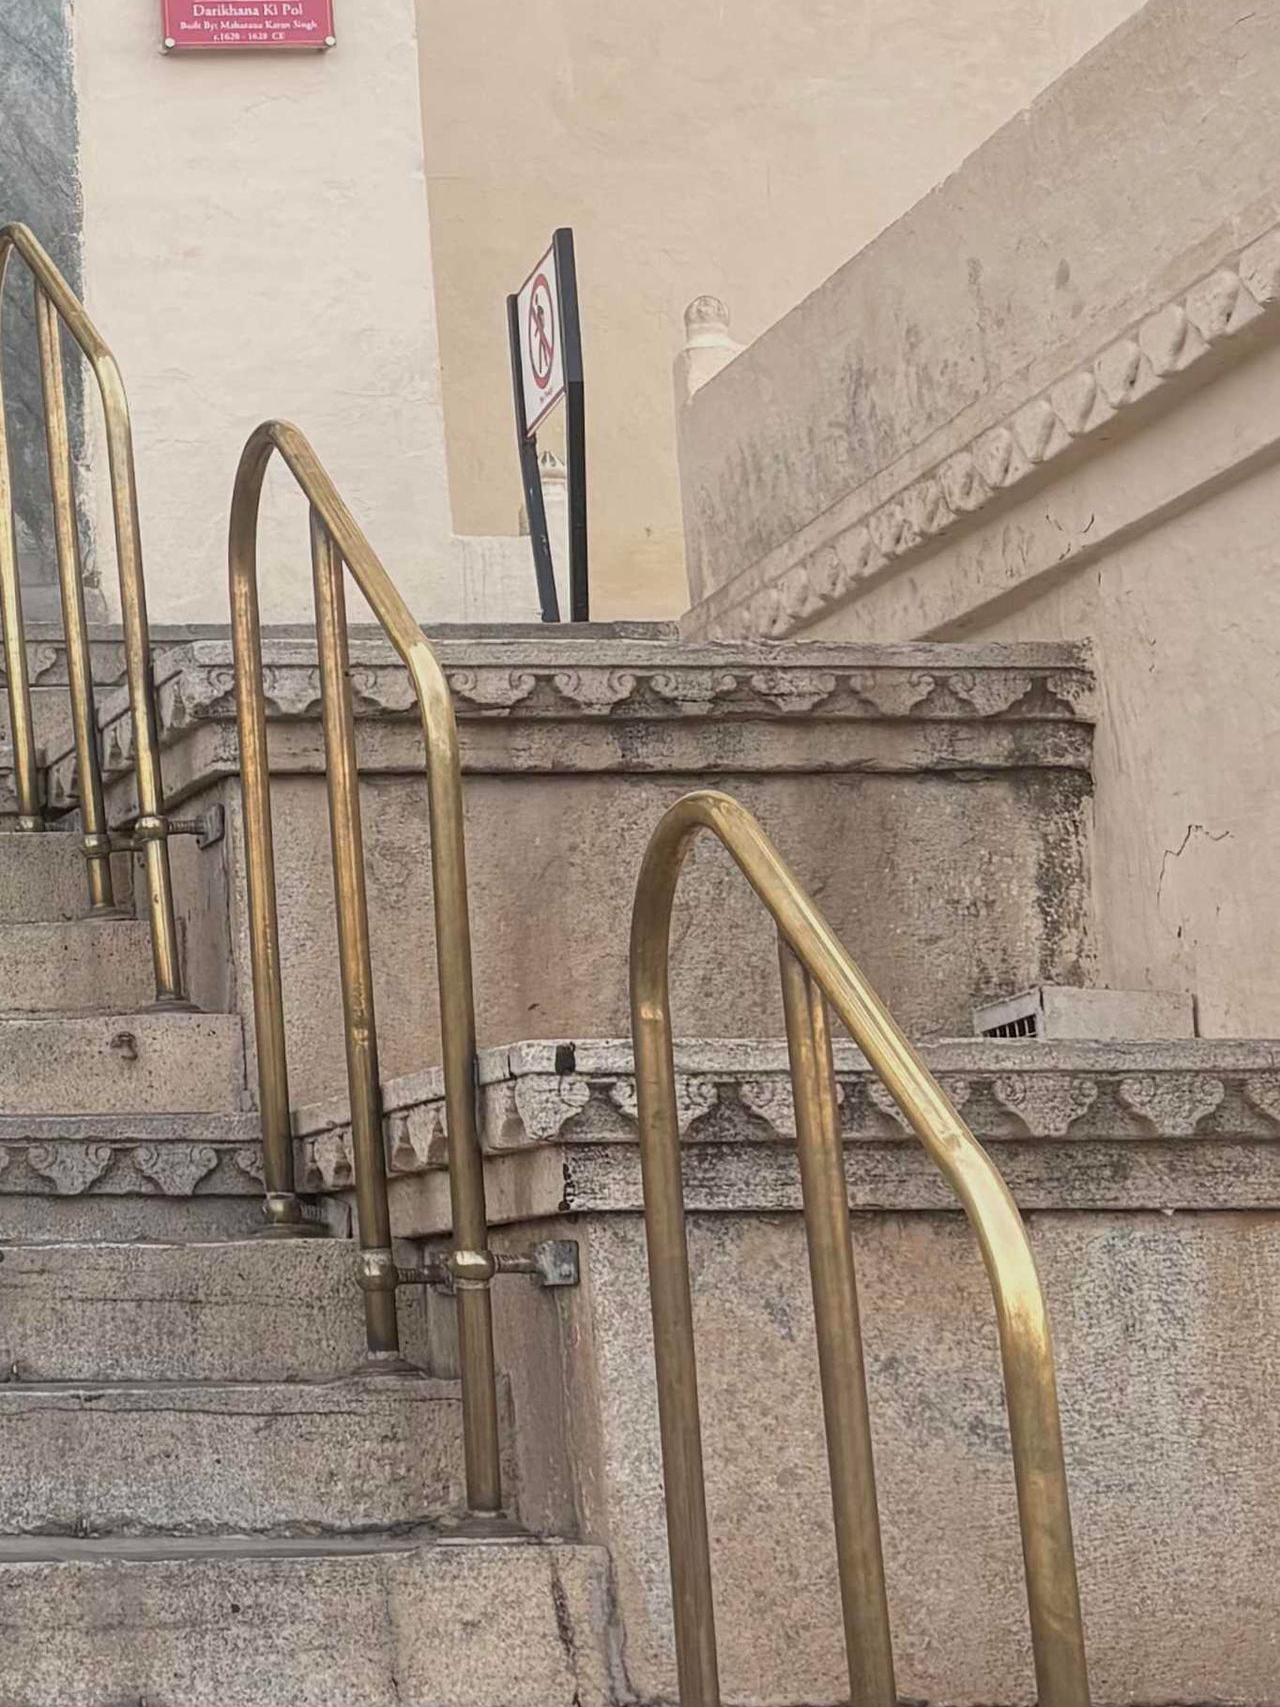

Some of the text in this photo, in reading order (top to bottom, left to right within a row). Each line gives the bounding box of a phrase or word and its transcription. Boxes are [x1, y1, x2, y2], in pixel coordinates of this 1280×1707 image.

[193, 3, 303, 17] Darikhana Ki Pol
